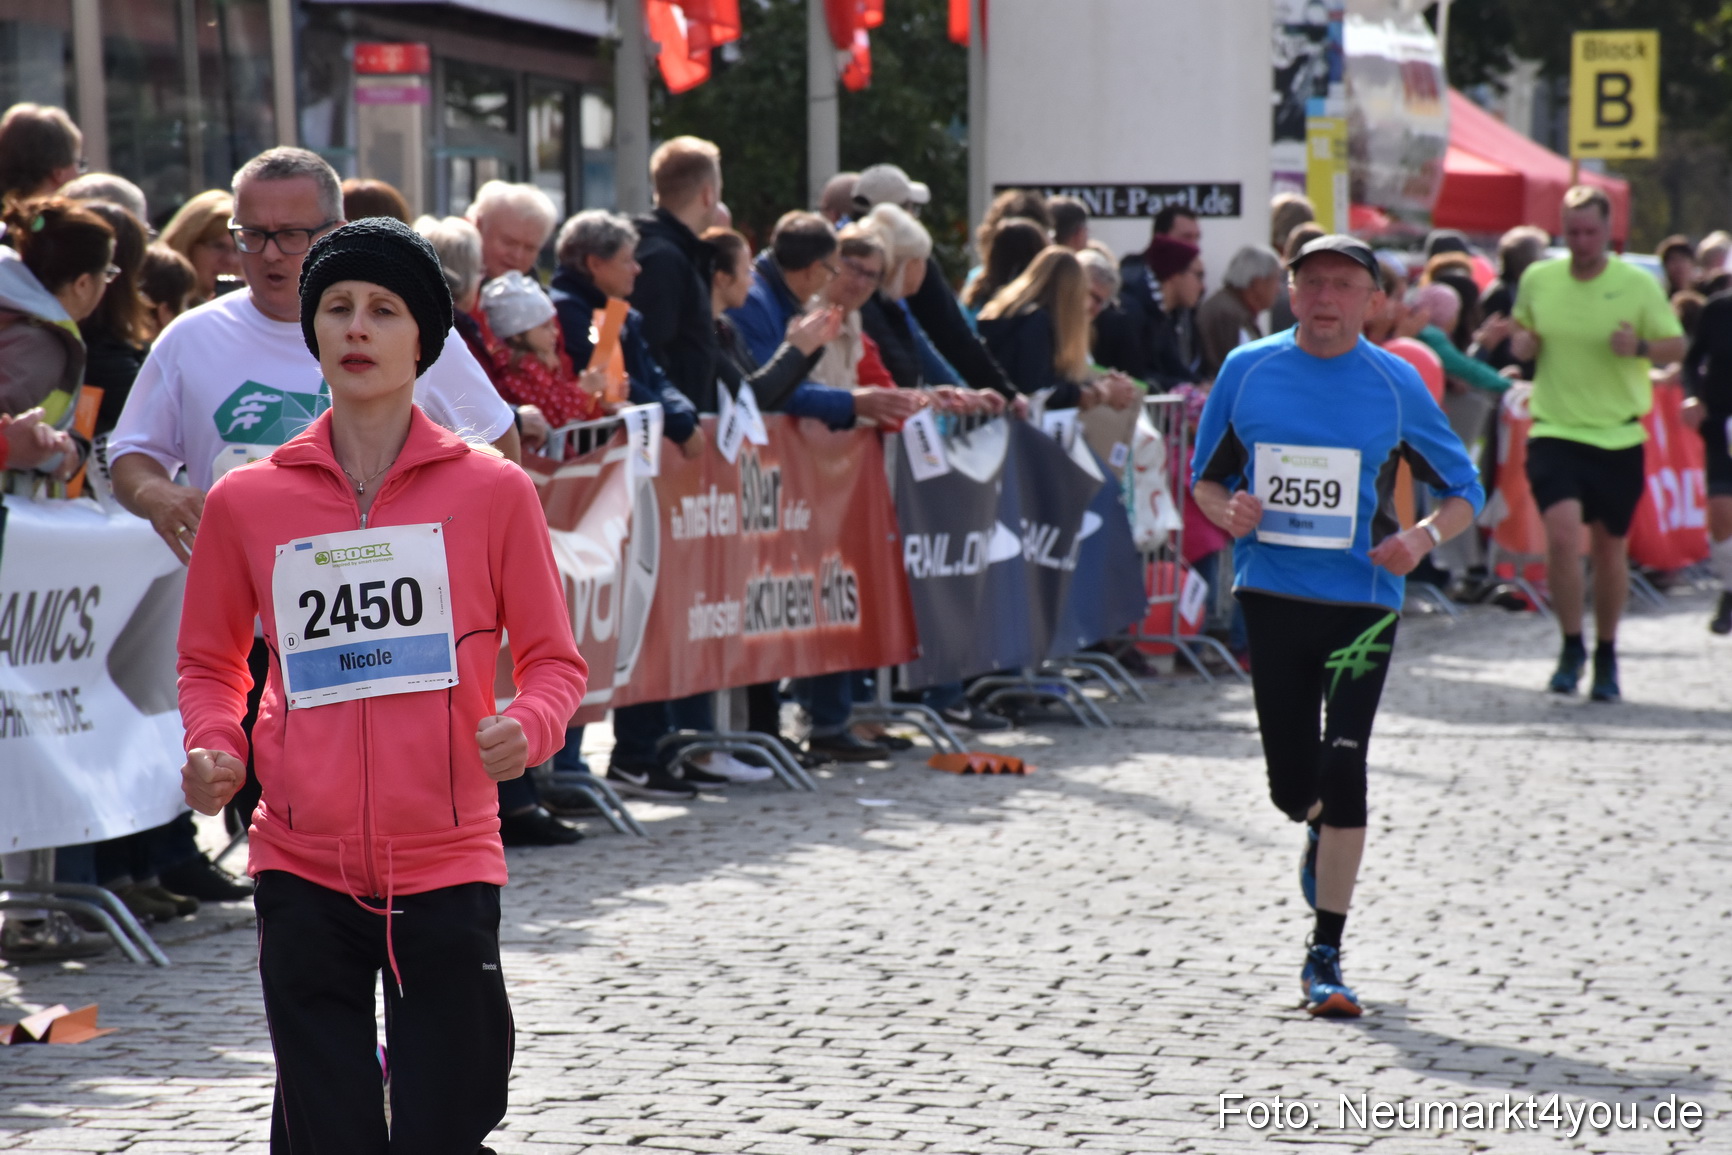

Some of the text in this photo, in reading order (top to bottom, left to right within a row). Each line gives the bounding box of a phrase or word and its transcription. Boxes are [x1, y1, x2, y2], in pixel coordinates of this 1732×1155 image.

[1595, 72, 1634, 129] B
[1268, 476, 1341, 509] 2559
[330, 543, 393, 563] BOCK
[298, 577, 423, 640] 2450
[0, 585, 101, 667] AMICS.
[289, 637, 295, 646] D
[339, 648, 393, 671] Nicole
